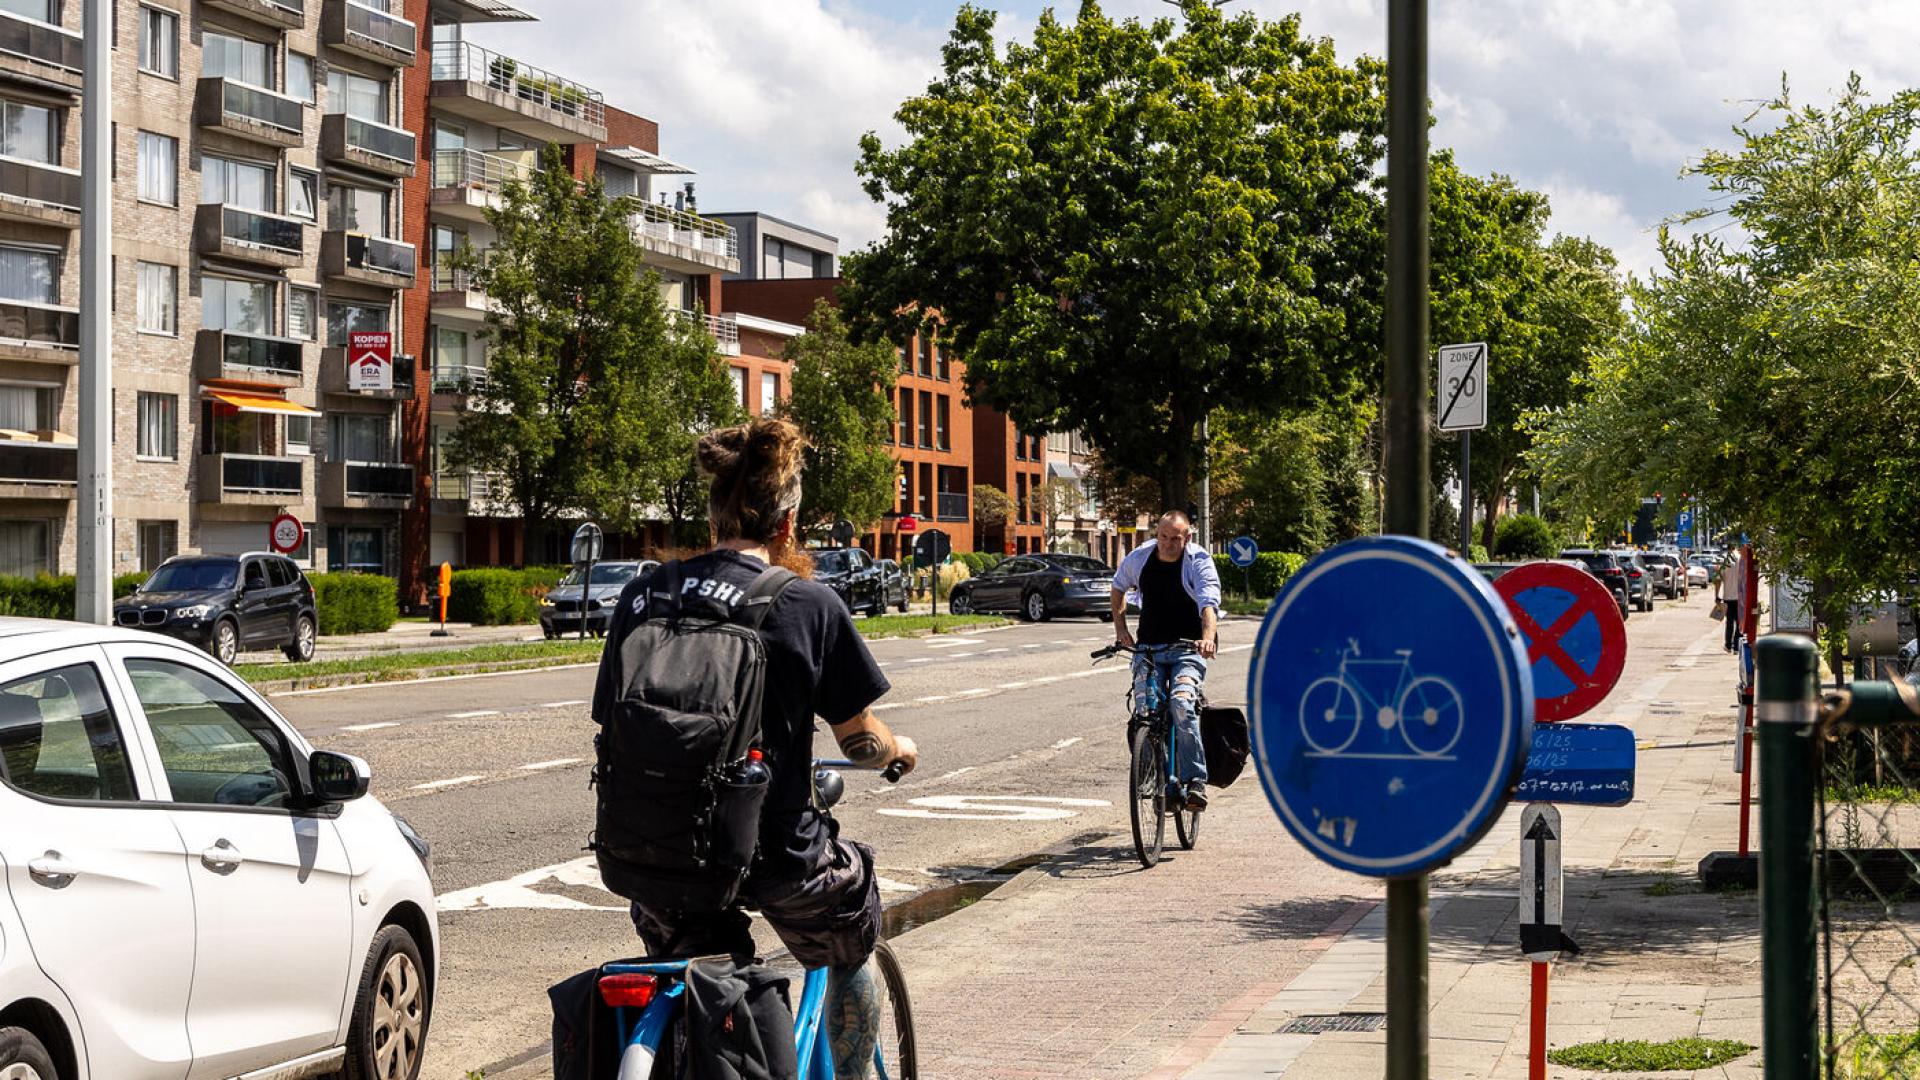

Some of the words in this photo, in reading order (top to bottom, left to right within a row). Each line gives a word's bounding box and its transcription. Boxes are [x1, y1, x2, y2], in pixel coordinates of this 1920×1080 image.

[354, 335, 388, 344] KOPEN
[1450, 352, 1474, 363] ZONE
[1448, 376, 1476, 399] 30
[1680, 513, 1690, 526] P
